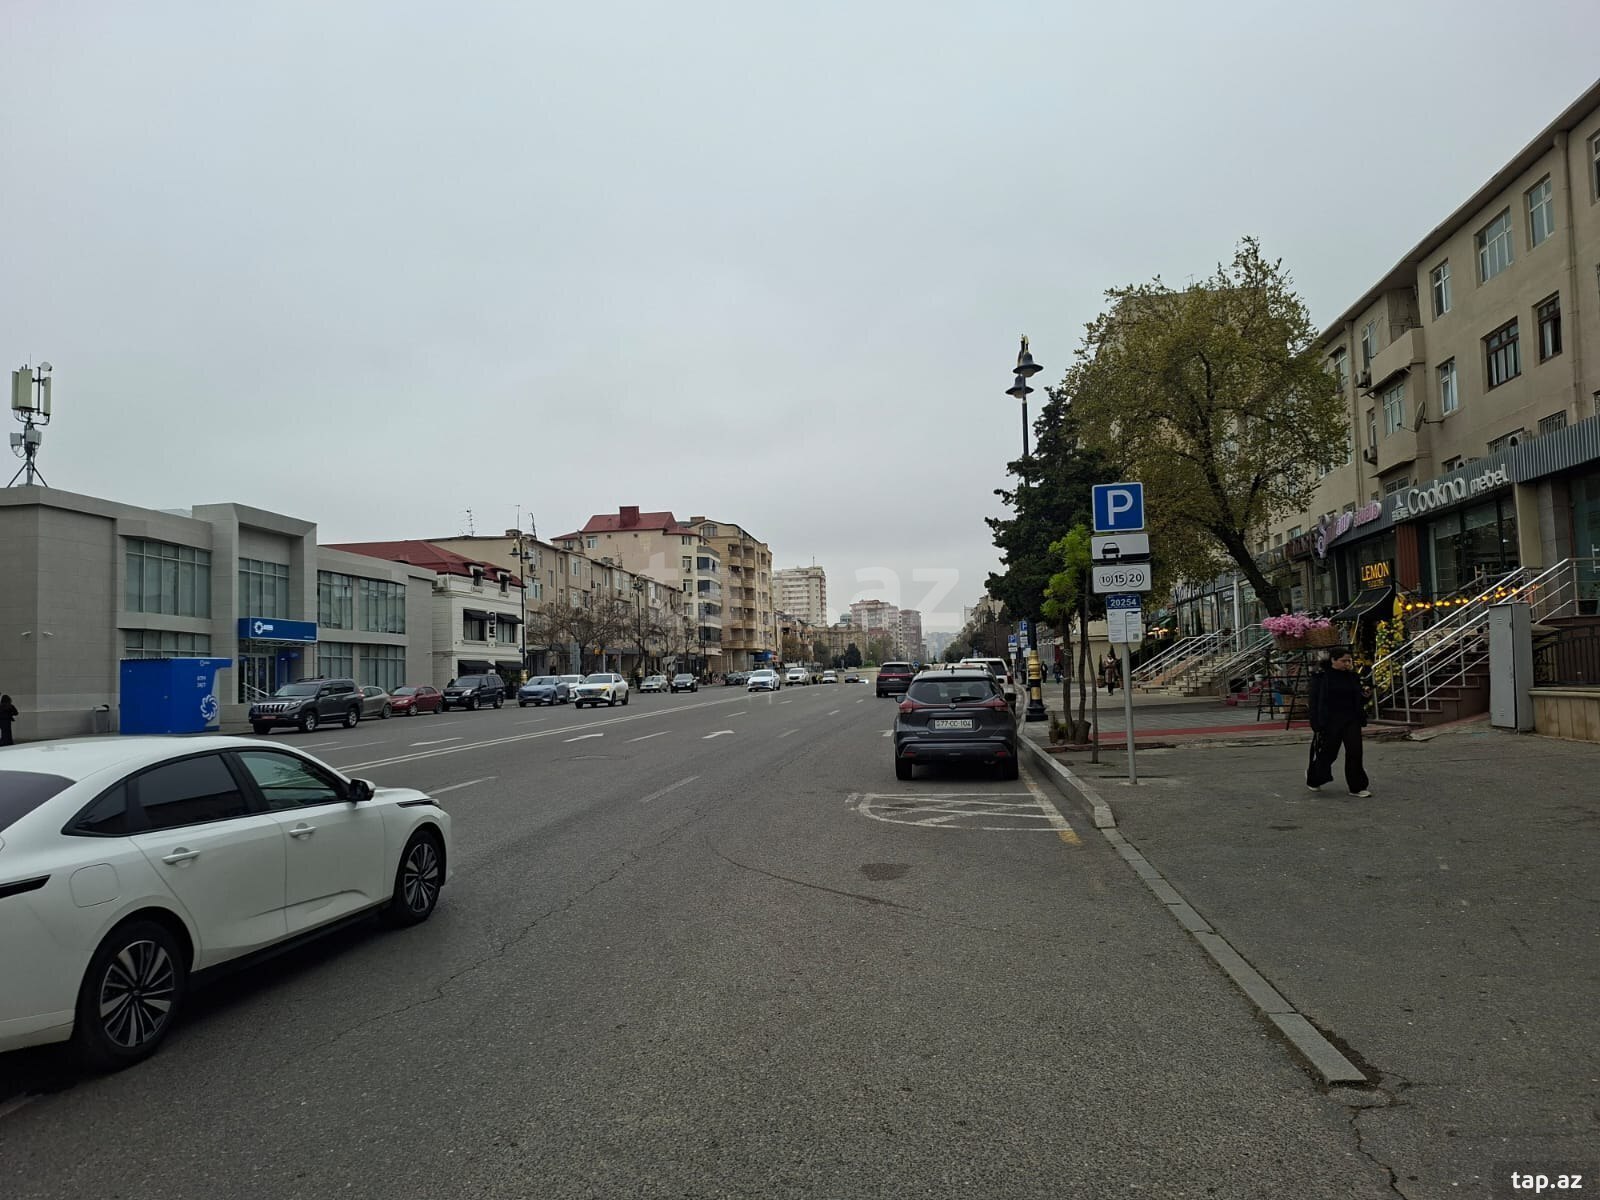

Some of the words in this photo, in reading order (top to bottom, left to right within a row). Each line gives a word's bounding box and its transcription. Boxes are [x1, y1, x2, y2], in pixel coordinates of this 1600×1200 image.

[1470, 464, 1510, 494] mebel
[1107, 489, 1134, 526] P
[1101, 576, 1111, 584] 10
[1114, 574, 1125, 583] 15
[1129, 573, 1142, 583] 20
[1361, 561, 1390, 581] LEMON
[1110, 598, 1137, 607] 20254
